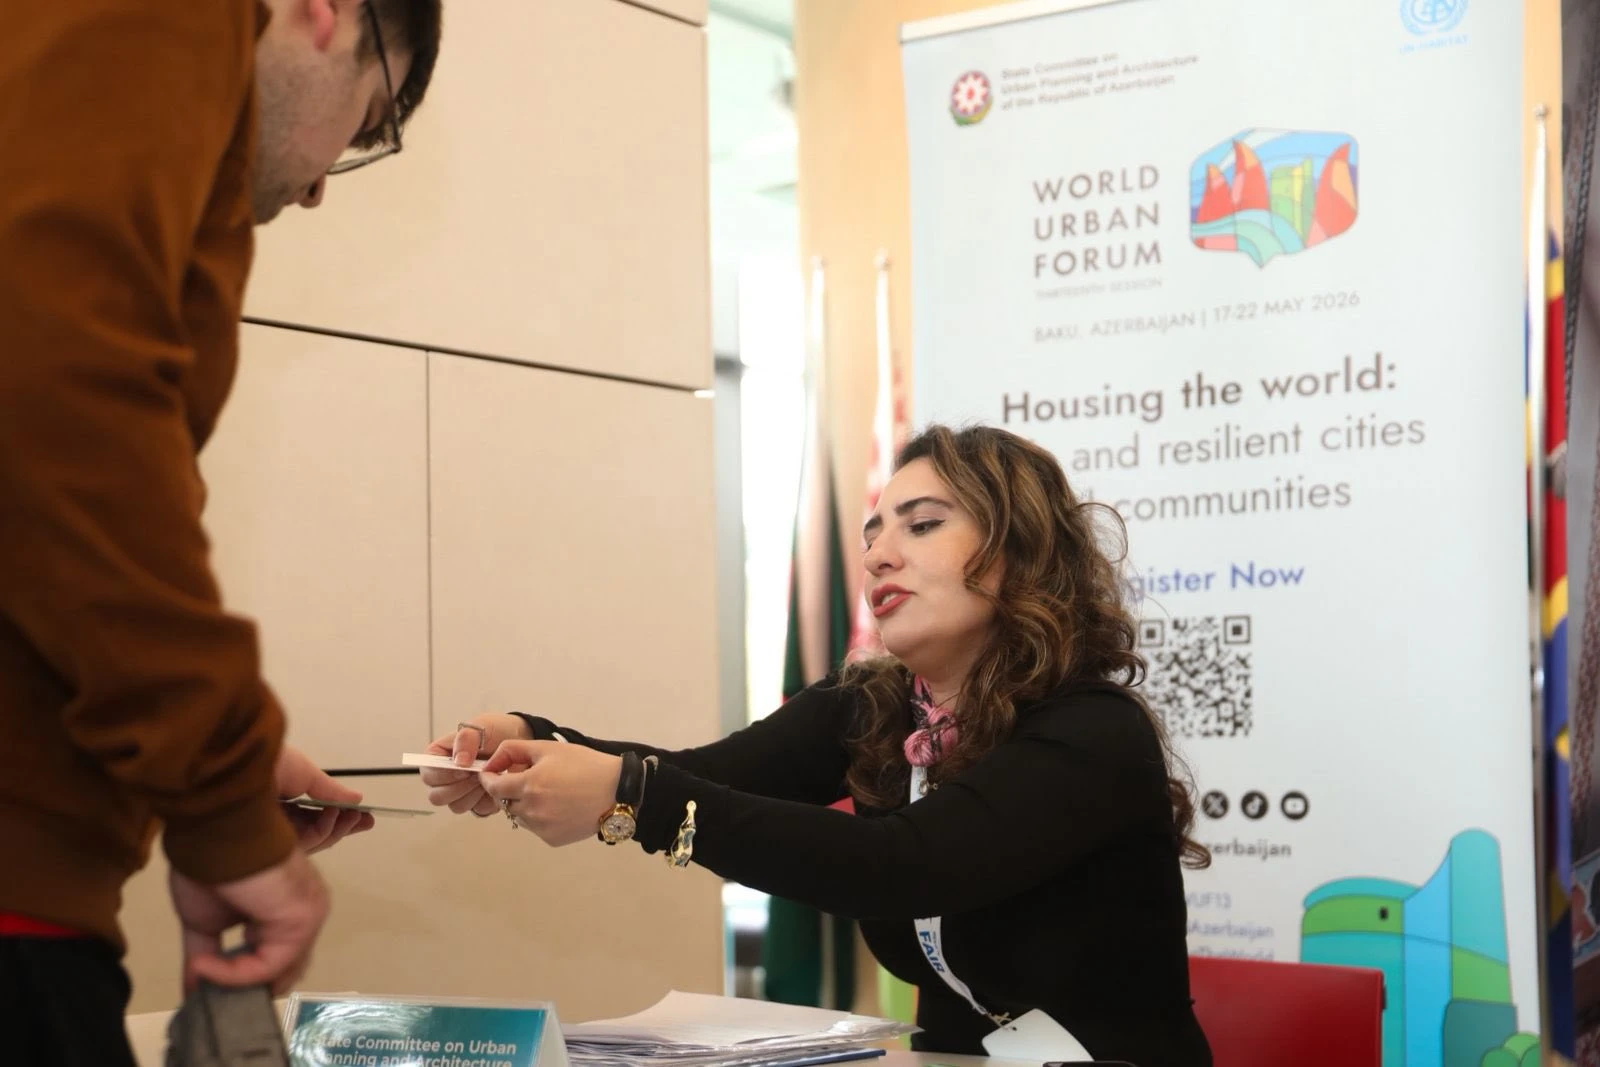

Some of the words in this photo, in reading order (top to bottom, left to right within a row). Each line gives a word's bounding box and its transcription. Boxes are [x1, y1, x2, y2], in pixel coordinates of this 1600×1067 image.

[1032, 164, 1160, 204] WORLD
[1034, 201, 1159, 241] URBAN
[1034, 240, 1162, 279] FORUM
[1090, 311, 1196, 337] AZERBAIJAN
[1263, 297, 1304, 316] MAY
[1311, 290, 1360, 312] 2026
[1001, 384, 1163, 423] Housing
[1182, 371, 1243, 409] the
[1260, 353, 1397, 400] world:
[1072, 433, 1140, 471] and
[1158, 423, 1302, 466] resilient
[1320, 413, 1426, 452] cities
[1114, 475, 1351, 523] communities
[1128, 566, 1215, 604] gister
[1229, 560, 1305, 590] Now
[919, 931, 946, 973] FAIR
[321, 1051, 378, 1067] anning
[380, 1053, 411, 1067] and
[355, 1035, 441, 1054] Committee
[445, 1041, 466, 1053] on
[469, 1039, 517, 1056] Urban
